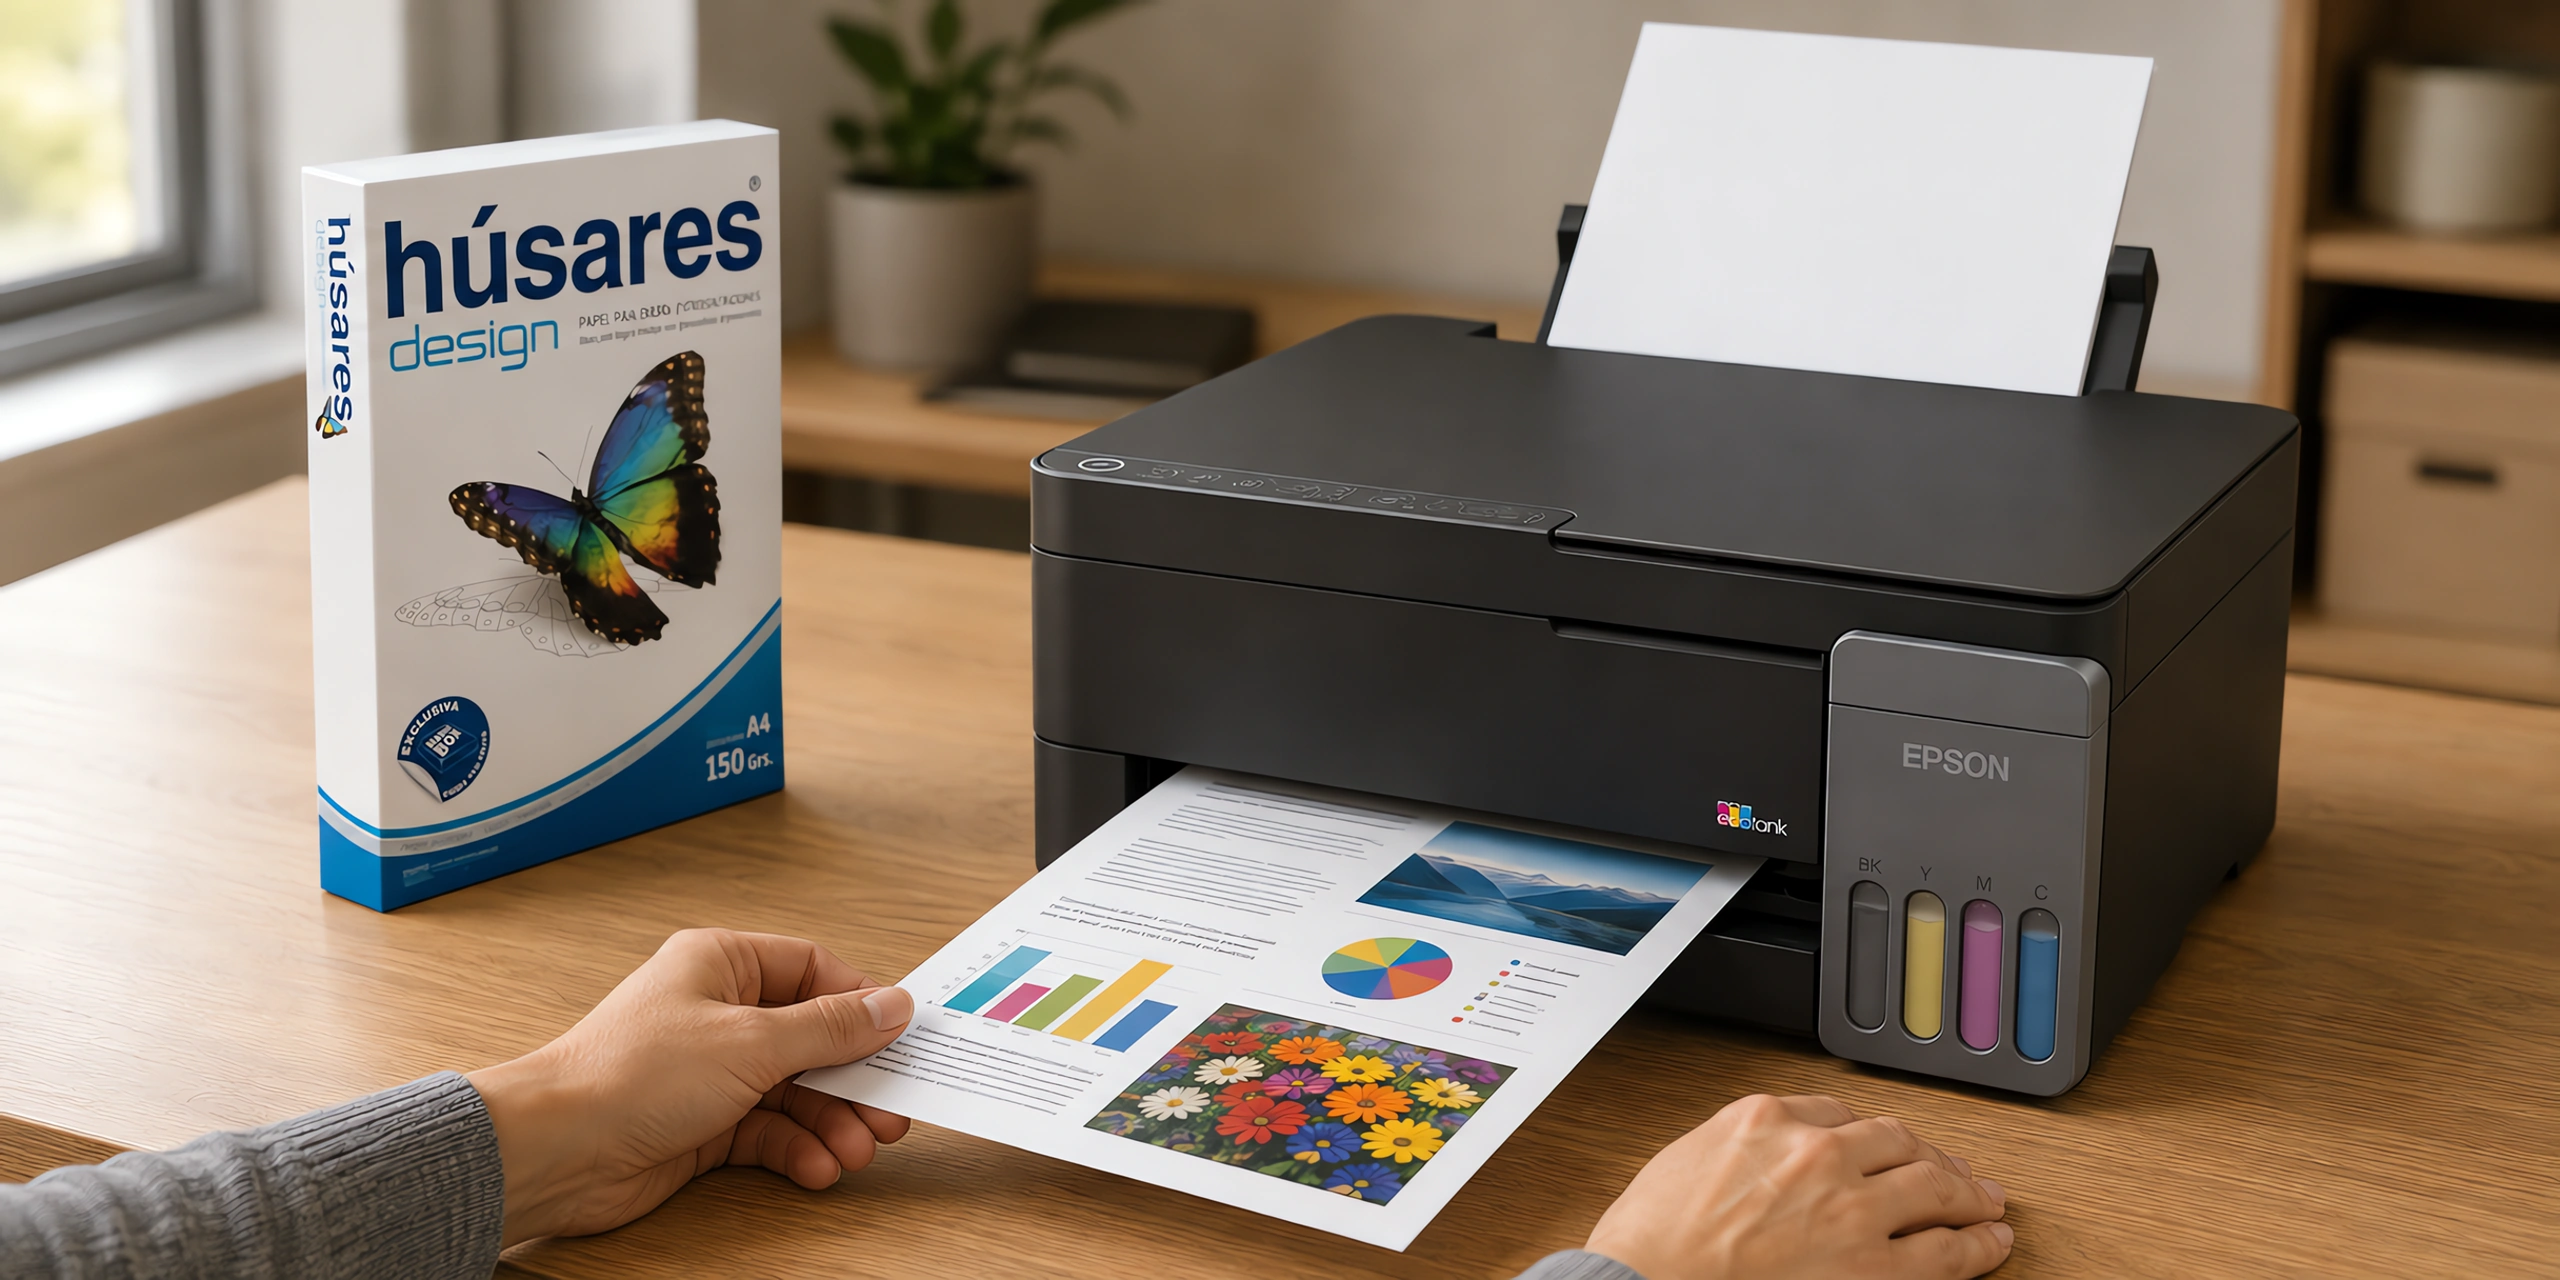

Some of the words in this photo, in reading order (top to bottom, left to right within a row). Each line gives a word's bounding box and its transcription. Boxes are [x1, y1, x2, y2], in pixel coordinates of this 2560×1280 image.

[385, 200, 762, 318] húsares
[328, 218, 355, 421] húsares
[389, 320, 559, 372] design
[746, 712, 771, 738] A4
[705, 747, 744, 782] 150
[1903, 742, 2009, 782] EPSON
[1859, 857, 1882, 874] BK
[1920, 866, 1932, 881] Y
[1976, 876, 1992, 892] M
[2034, 884, 2048, 900] C
